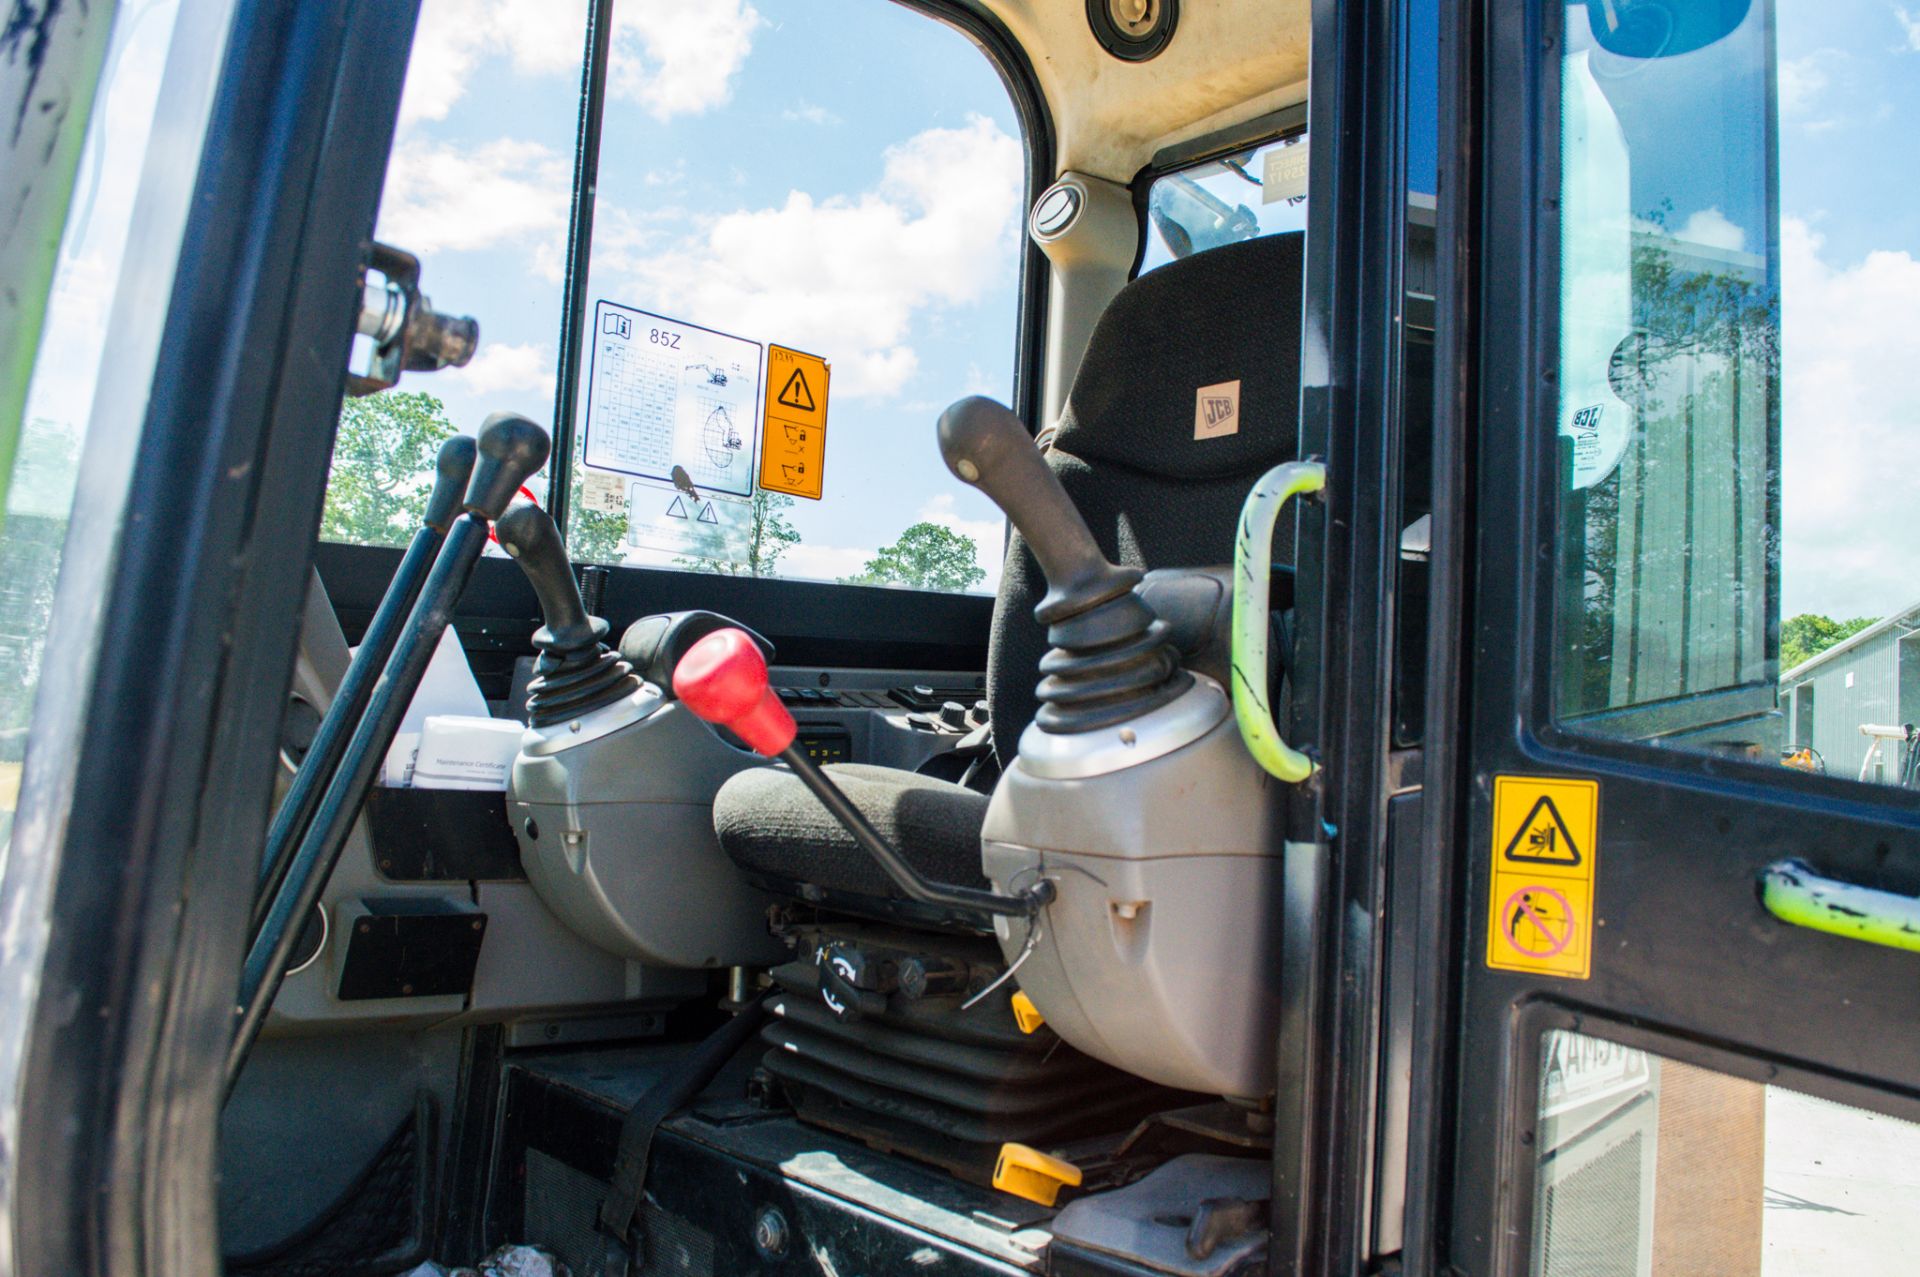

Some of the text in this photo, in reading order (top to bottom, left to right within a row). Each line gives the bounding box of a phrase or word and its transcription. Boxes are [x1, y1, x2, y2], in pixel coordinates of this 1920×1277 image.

[649, 328, 681, 350] 85Z
[1207, 399, 1233, 425] JCB
[436, 758, 507, 770] Maintenance Certificate
